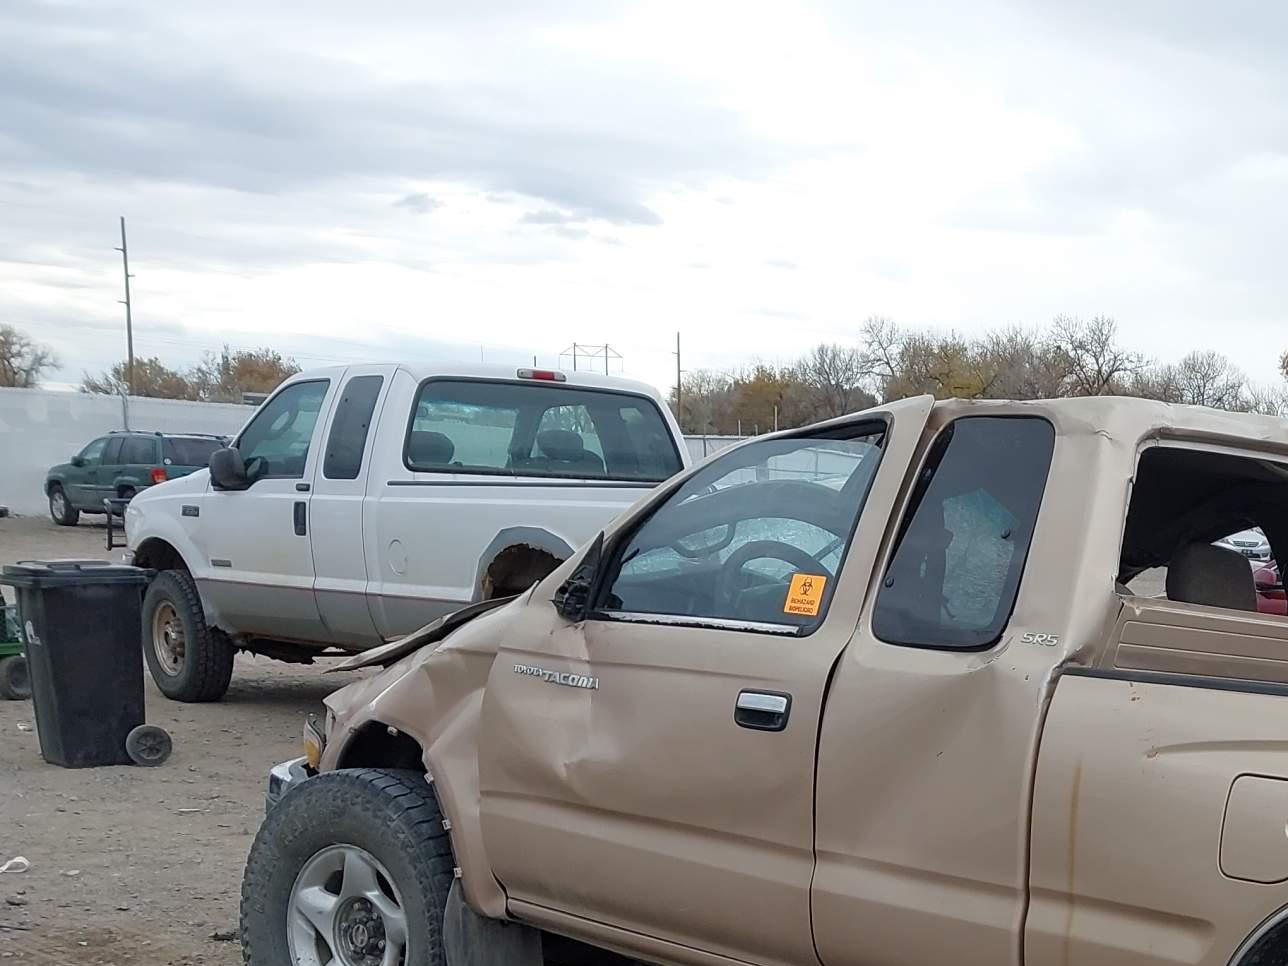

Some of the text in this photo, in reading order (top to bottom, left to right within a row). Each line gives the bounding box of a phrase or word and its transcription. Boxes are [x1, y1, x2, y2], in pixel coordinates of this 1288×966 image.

[1021, 632, 1060, 647] SR5
[513, 664, 600, 689] TOYOTA TACOMA
